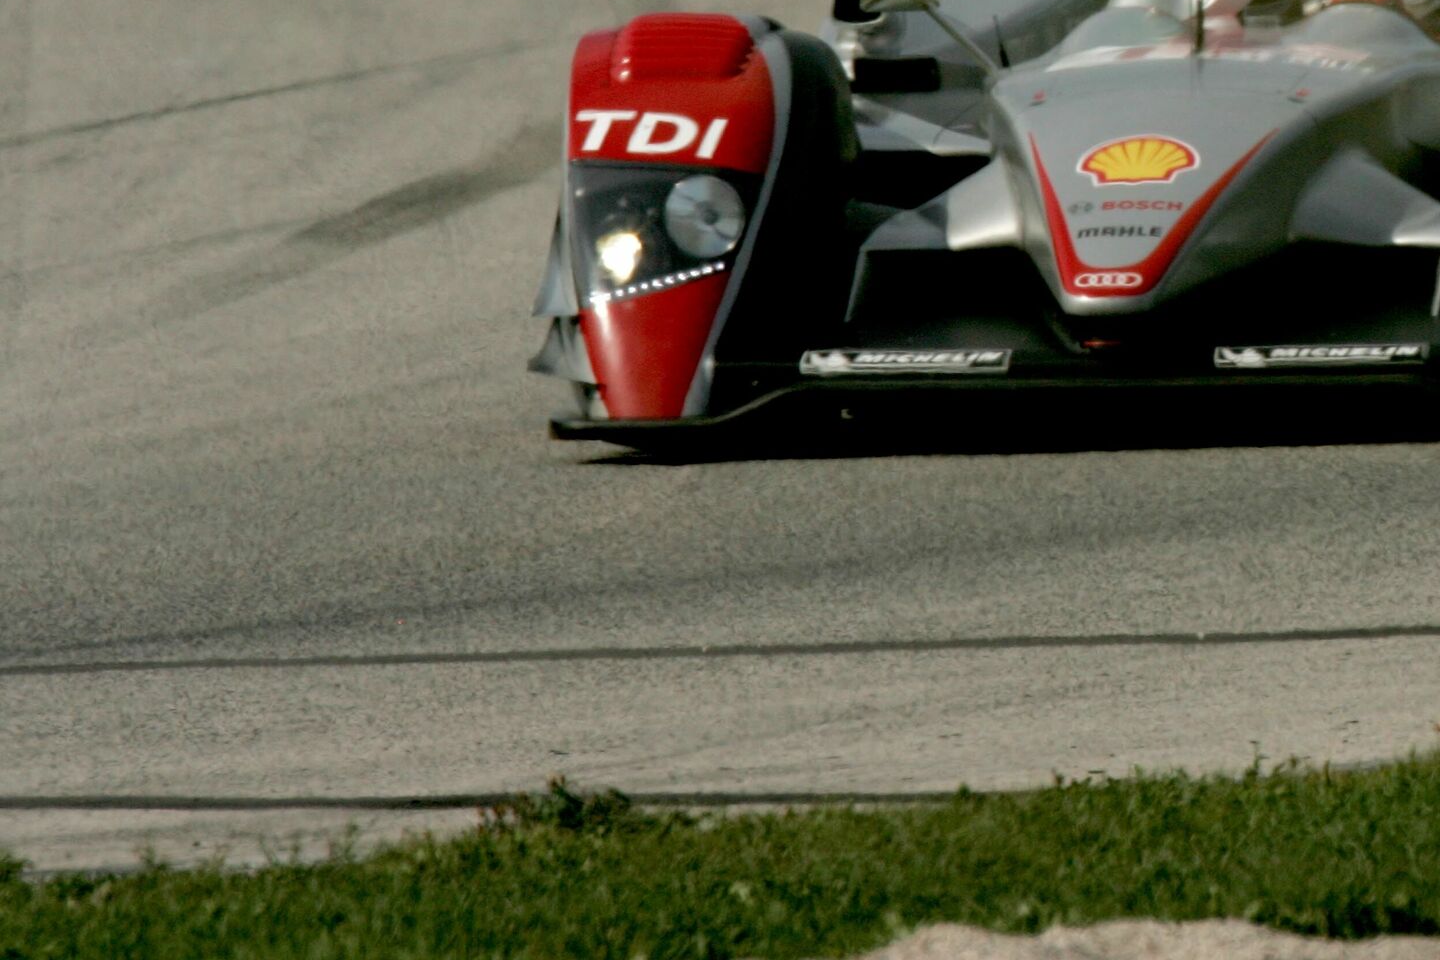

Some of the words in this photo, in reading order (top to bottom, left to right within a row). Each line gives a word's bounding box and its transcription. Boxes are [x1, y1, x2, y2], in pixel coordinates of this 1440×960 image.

[575, 109, 729, 159] TDI
[1102, 200, 1184, 211] BOSCH
[1077, 226, 1162, 239] MAHLE
[1269, 346, 1421, 358] MICHELIN
